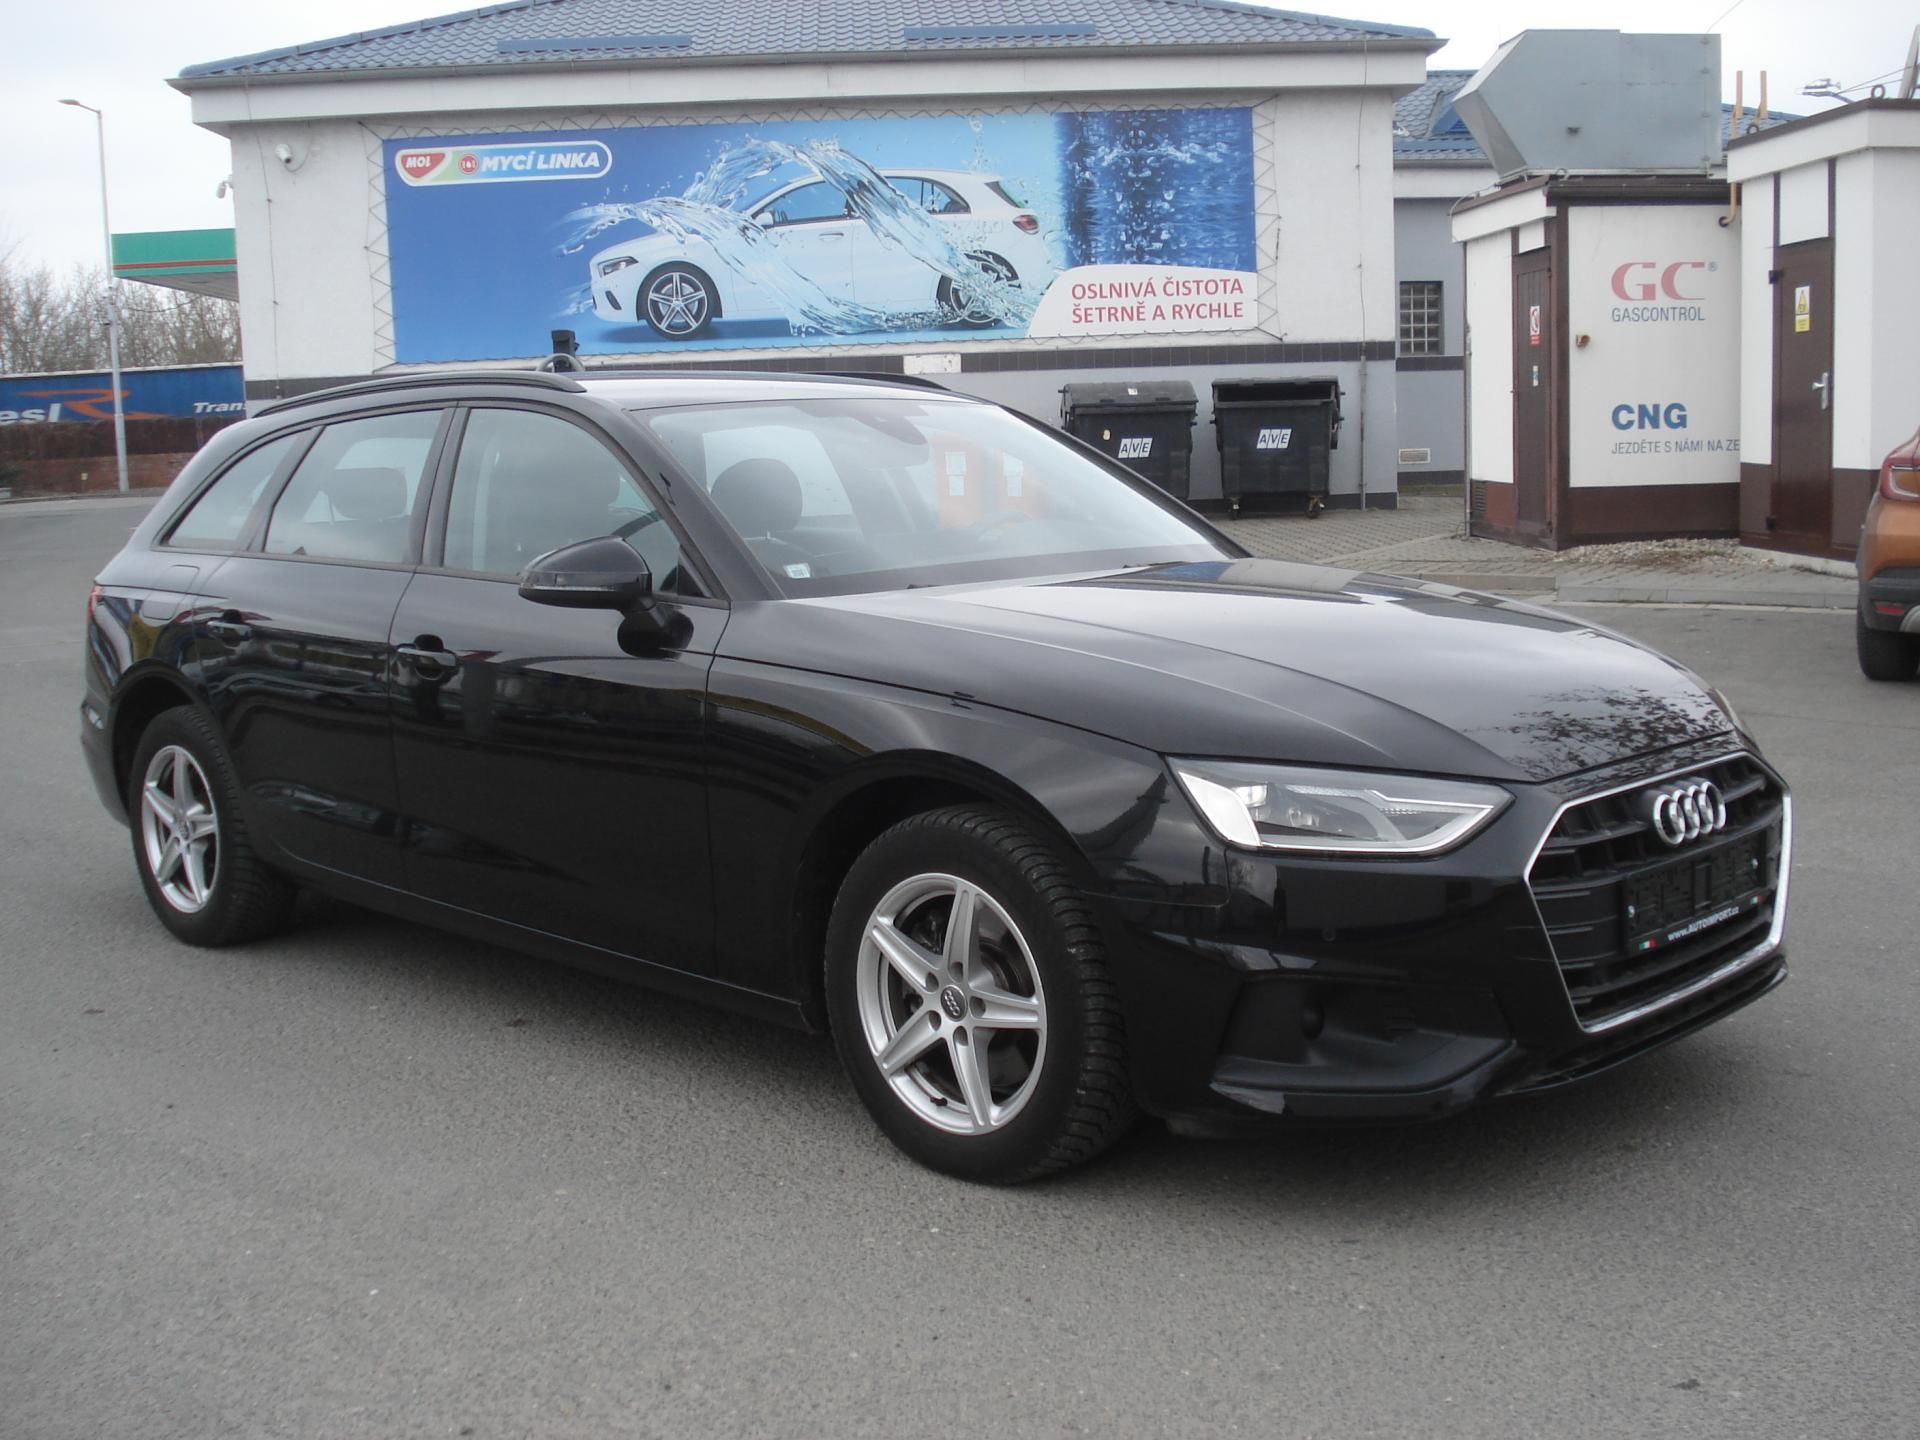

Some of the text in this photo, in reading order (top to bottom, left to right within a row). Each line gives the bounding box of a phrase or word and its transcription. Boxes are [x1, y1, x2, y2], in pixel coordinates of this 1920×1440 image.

[406, 156, 431, 168] MOL
[482, 151, 600, 172] MYCÍ LINKA
[1071, 276, 1244, 300] OSLNIVÁ ČISTOTA
[1072, 301, 1244, 324] ŠETRNĚ A RYCHLE
[1611, 306, 1706, 322] GASCONTROL
[1611, 403, 1688, 431] CNG
[1258, 431, 1290, 446] AVE
[1611, 439, 1661, 455] JEZDĚTE
[1664, 441, 1672, 453] S
[1675, 438, 1703, 453] NÁMI
[1707, 440, 1723, 452] NA
[1119, 440, 1150, 456] AVE
